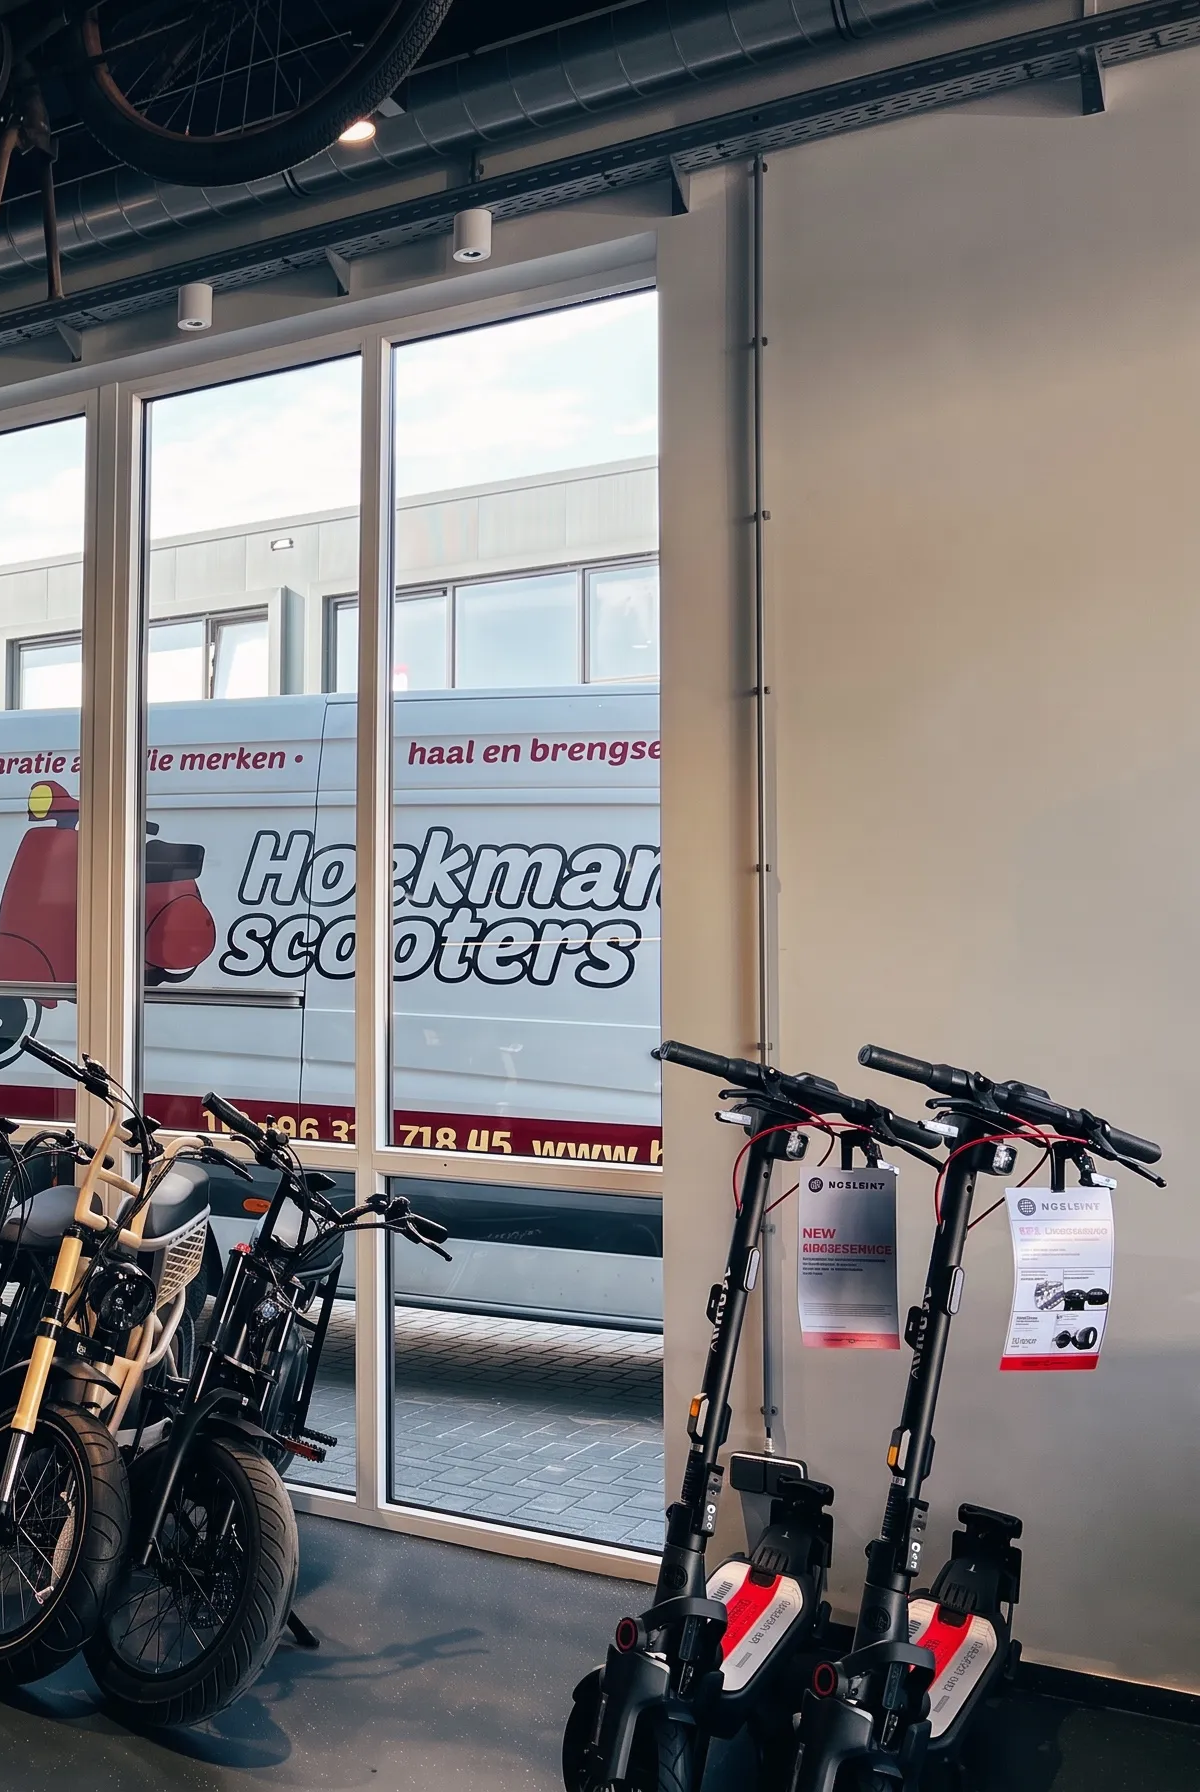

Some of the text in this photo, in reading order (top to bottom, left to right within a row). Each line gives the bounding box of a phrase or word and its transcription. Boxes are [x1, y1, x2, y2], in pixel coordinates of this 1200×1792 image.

[179, 747, 286, 771] merken
[408, 740, 475, 765] haal
[482, 744, 521, 763] en
[218, 905, 643, 990] scooters
[802, 1228, 836, 1239] NEW
